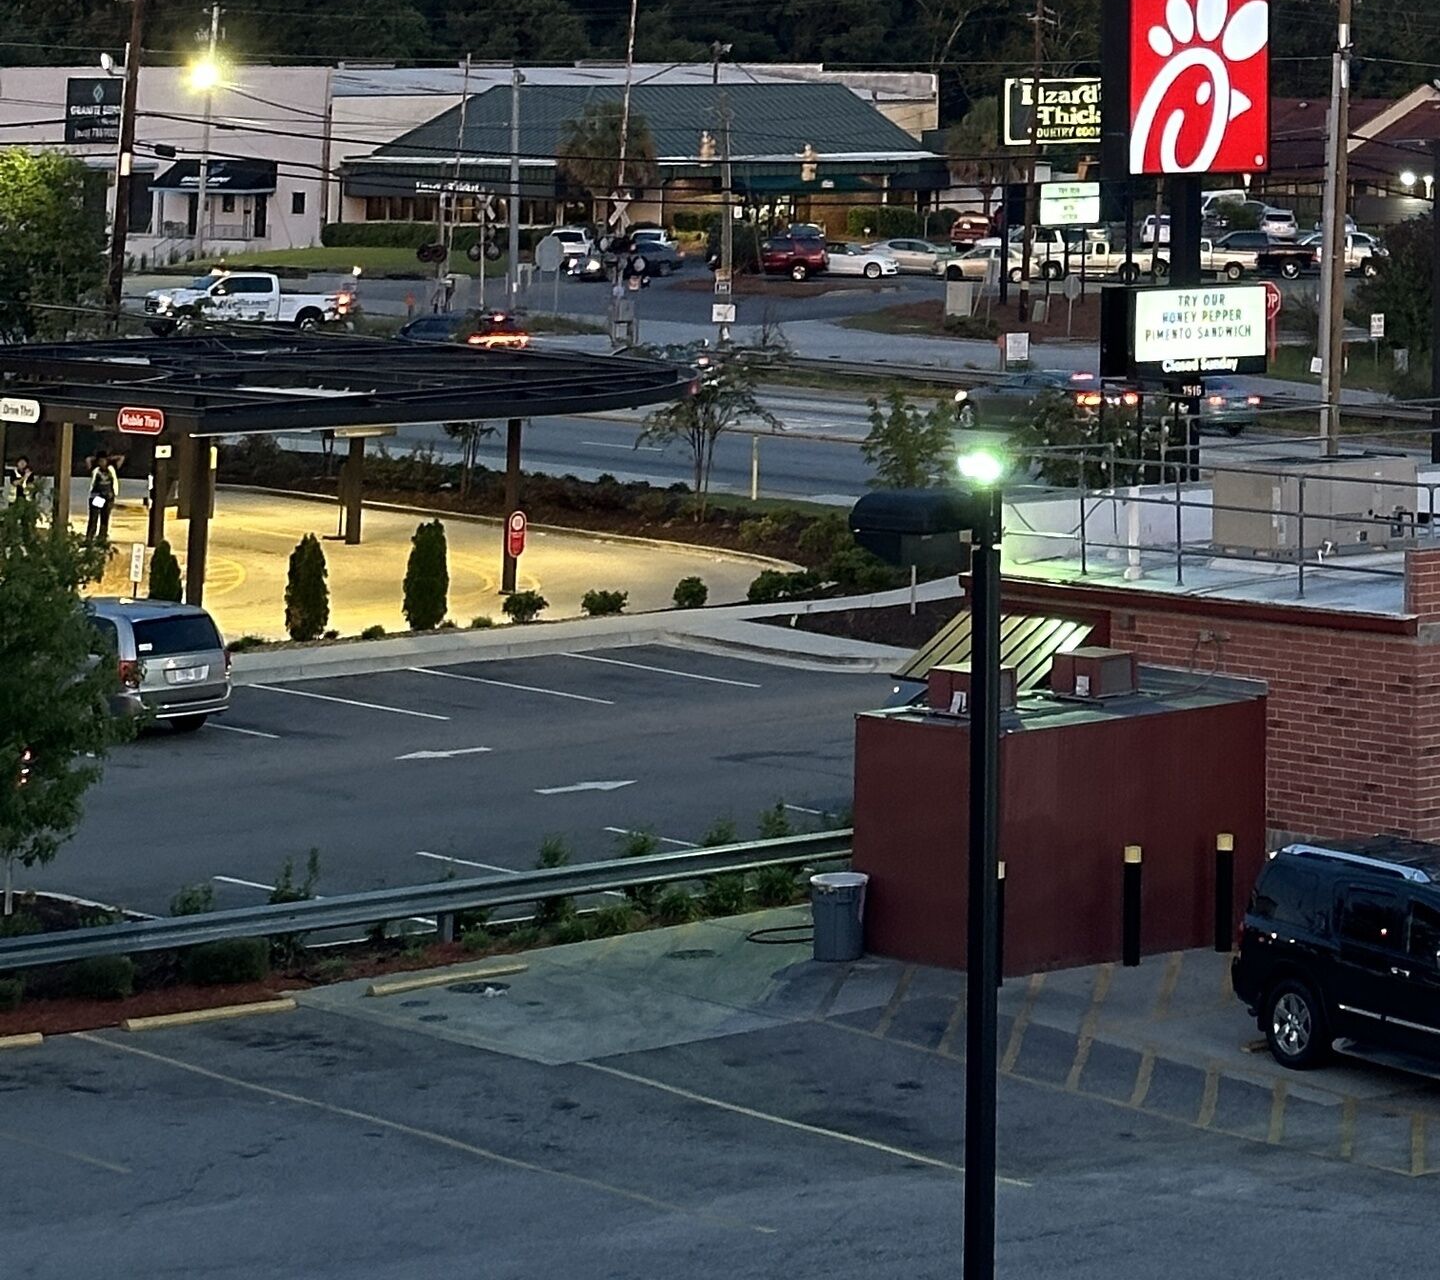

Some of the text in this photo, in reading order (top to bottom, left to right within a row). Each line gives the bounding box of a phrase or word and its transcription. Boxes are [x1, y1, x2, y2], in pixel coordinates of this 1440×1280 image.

[1021, 83, 1102, 105] Lizard'
[1036, 127, 1074, 138] OUNTRY
[1178, 293, 1226, 308] TRY OUR
[1162, 308, 1242, 325] HONEY PEPPER
[1145, 324, 1251, 342] PIMENTO SANDWICH
[1162, 356, 1239, 373] Closed Sunday
[3, 403, 35, 417] Drive Thru
[121, 413, 160, 428] Mobile Thru
